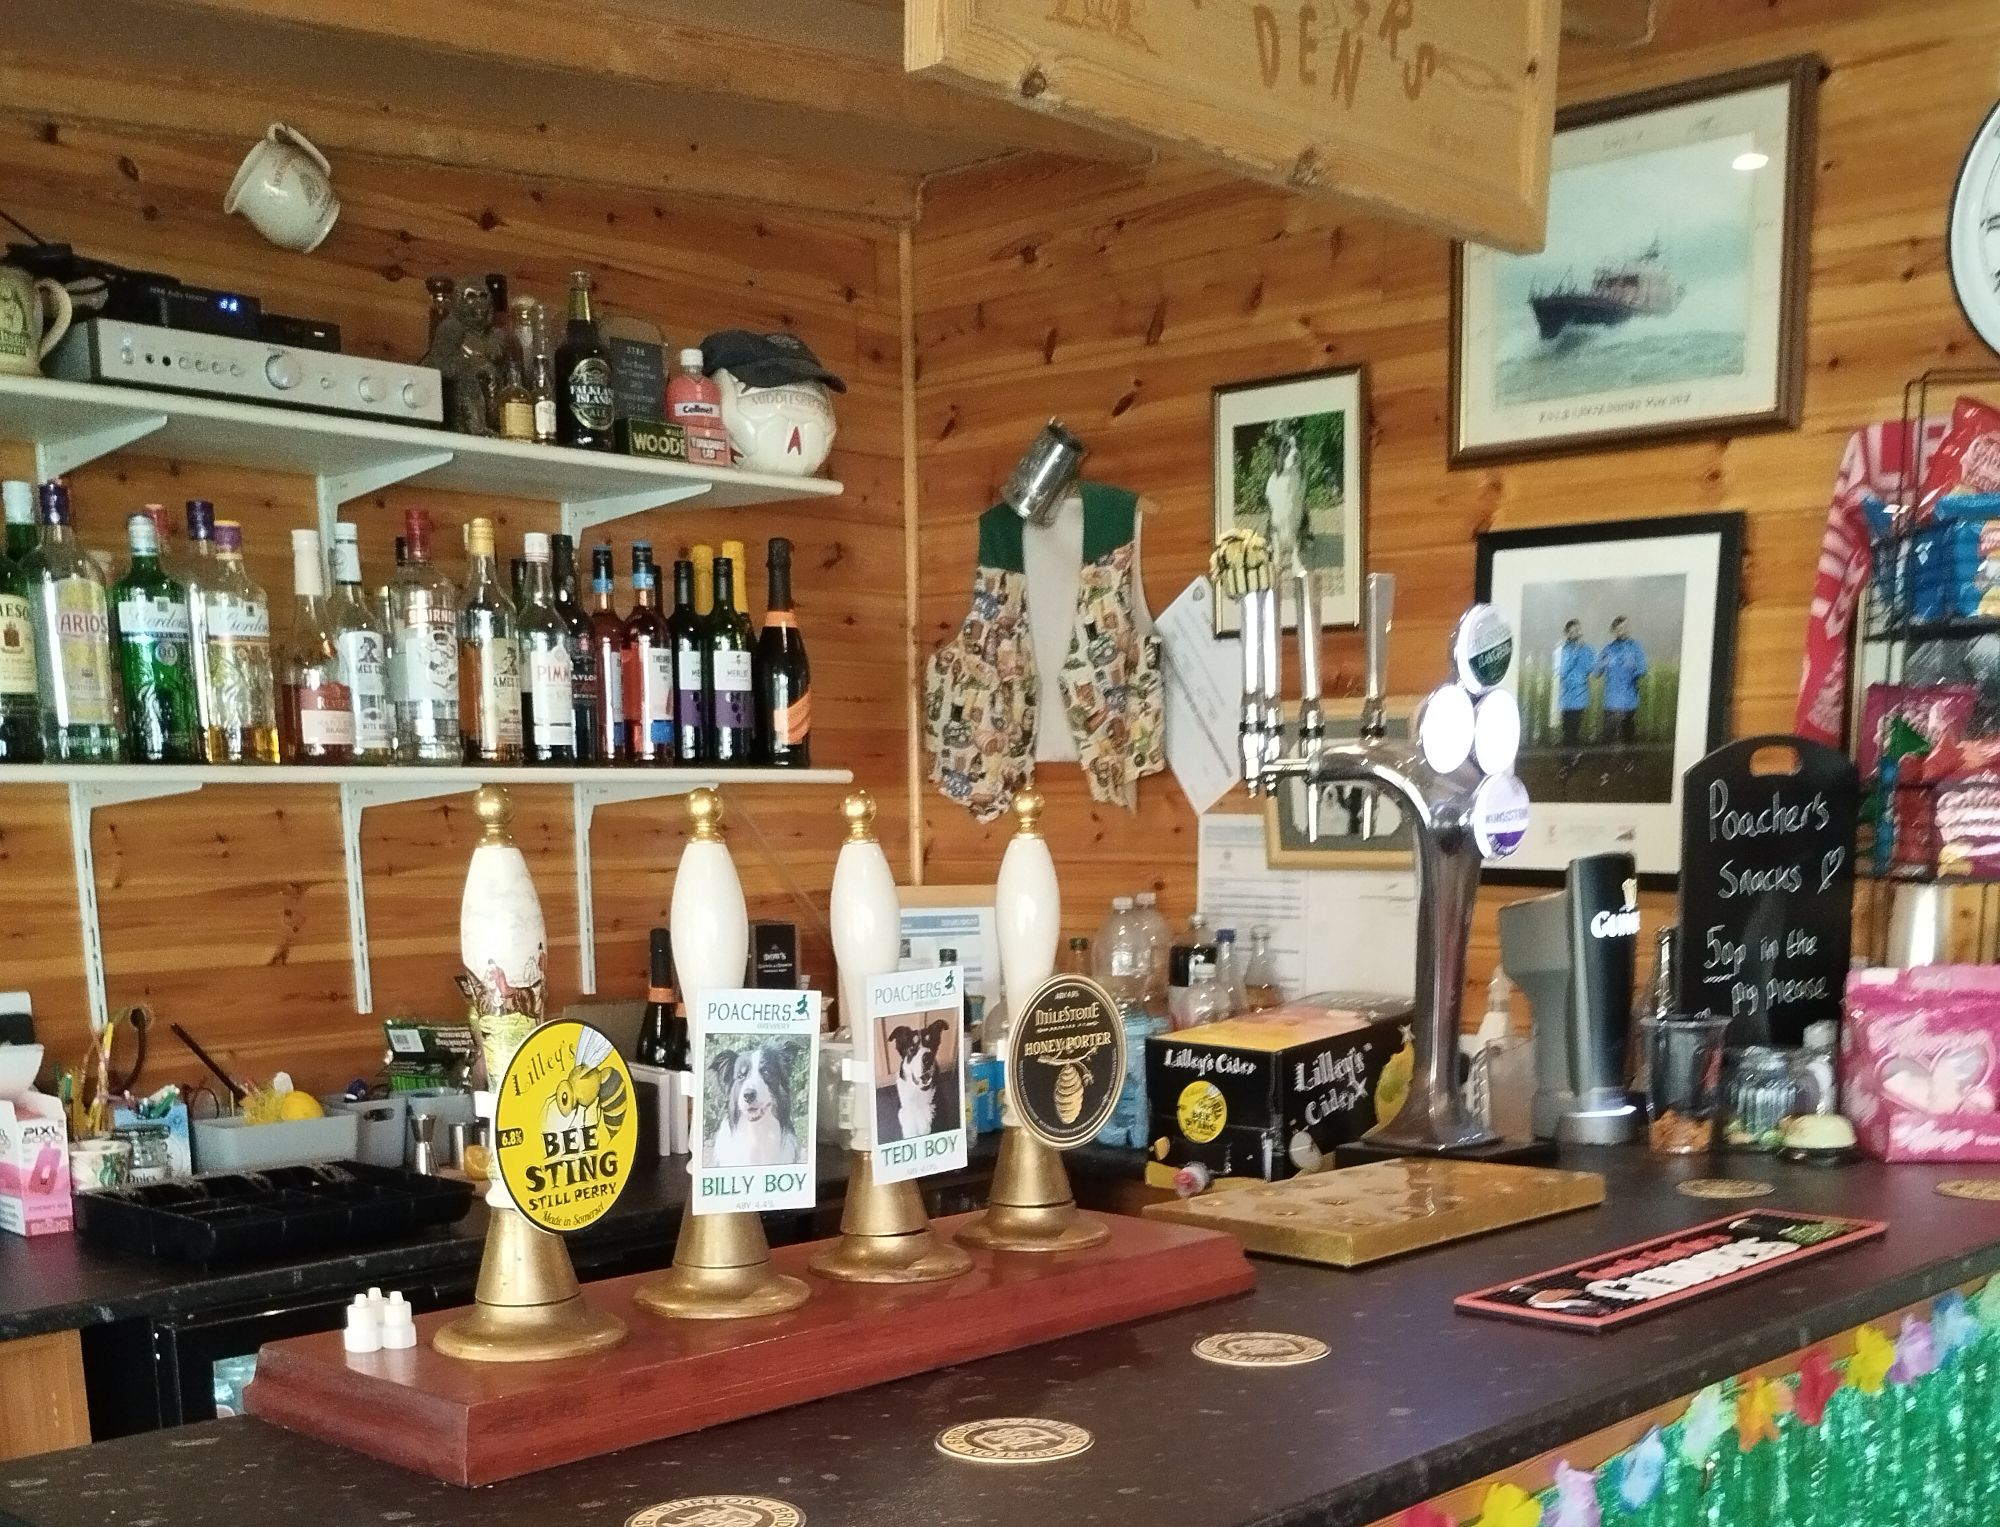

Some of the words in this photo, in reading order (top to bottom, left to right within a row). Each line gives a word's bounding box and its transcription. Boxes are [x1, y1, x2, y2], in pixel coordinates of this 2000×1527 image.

[1253, 4, 1364, 110] DEN
[60, 613, 108, 633] ARIOS
[1709, 778, 1829, 842] Poacher's
[1760, 935, 1779, 962] in
[1786, 928, 1818, 958] the
[874, 980, 942, 1005] POACHERS
[707, 1001, 792, 1022] POACHERS
[1024, 1038, 1062, 1056] HONEY
[1065, 1031, 1112, 1052] PORTER
[512, 1039, 575, 1097] Lilley's
[1163, 1048, 1214, 1077] Lilley's
[1215, 1053, 1257, 1075] Cider
[23, 1125, 60, 1137] PIXL
[501, 1129, 522, 1147] 6.8%
[541, 1124, 600, 1160] BEE
[880, 1145, 918, 1167] TEDI
[925, 1136, 958, 1156] BOY
[525, 1150, 619, 1193] STING
[529, 1194, 571, 1212] STILL
[574, 1182, 618, 1202] PERRY
[702, 1175, 755, 1198] BILLY
[764, 1173, 808, 1192] BOY
[542, 1210, 561, 1227] Made
[563, 1213, 572, 1225] in
[573, 1202, 605, 1226] Somerset
[656, 1496, 763, 1514] BURTON
